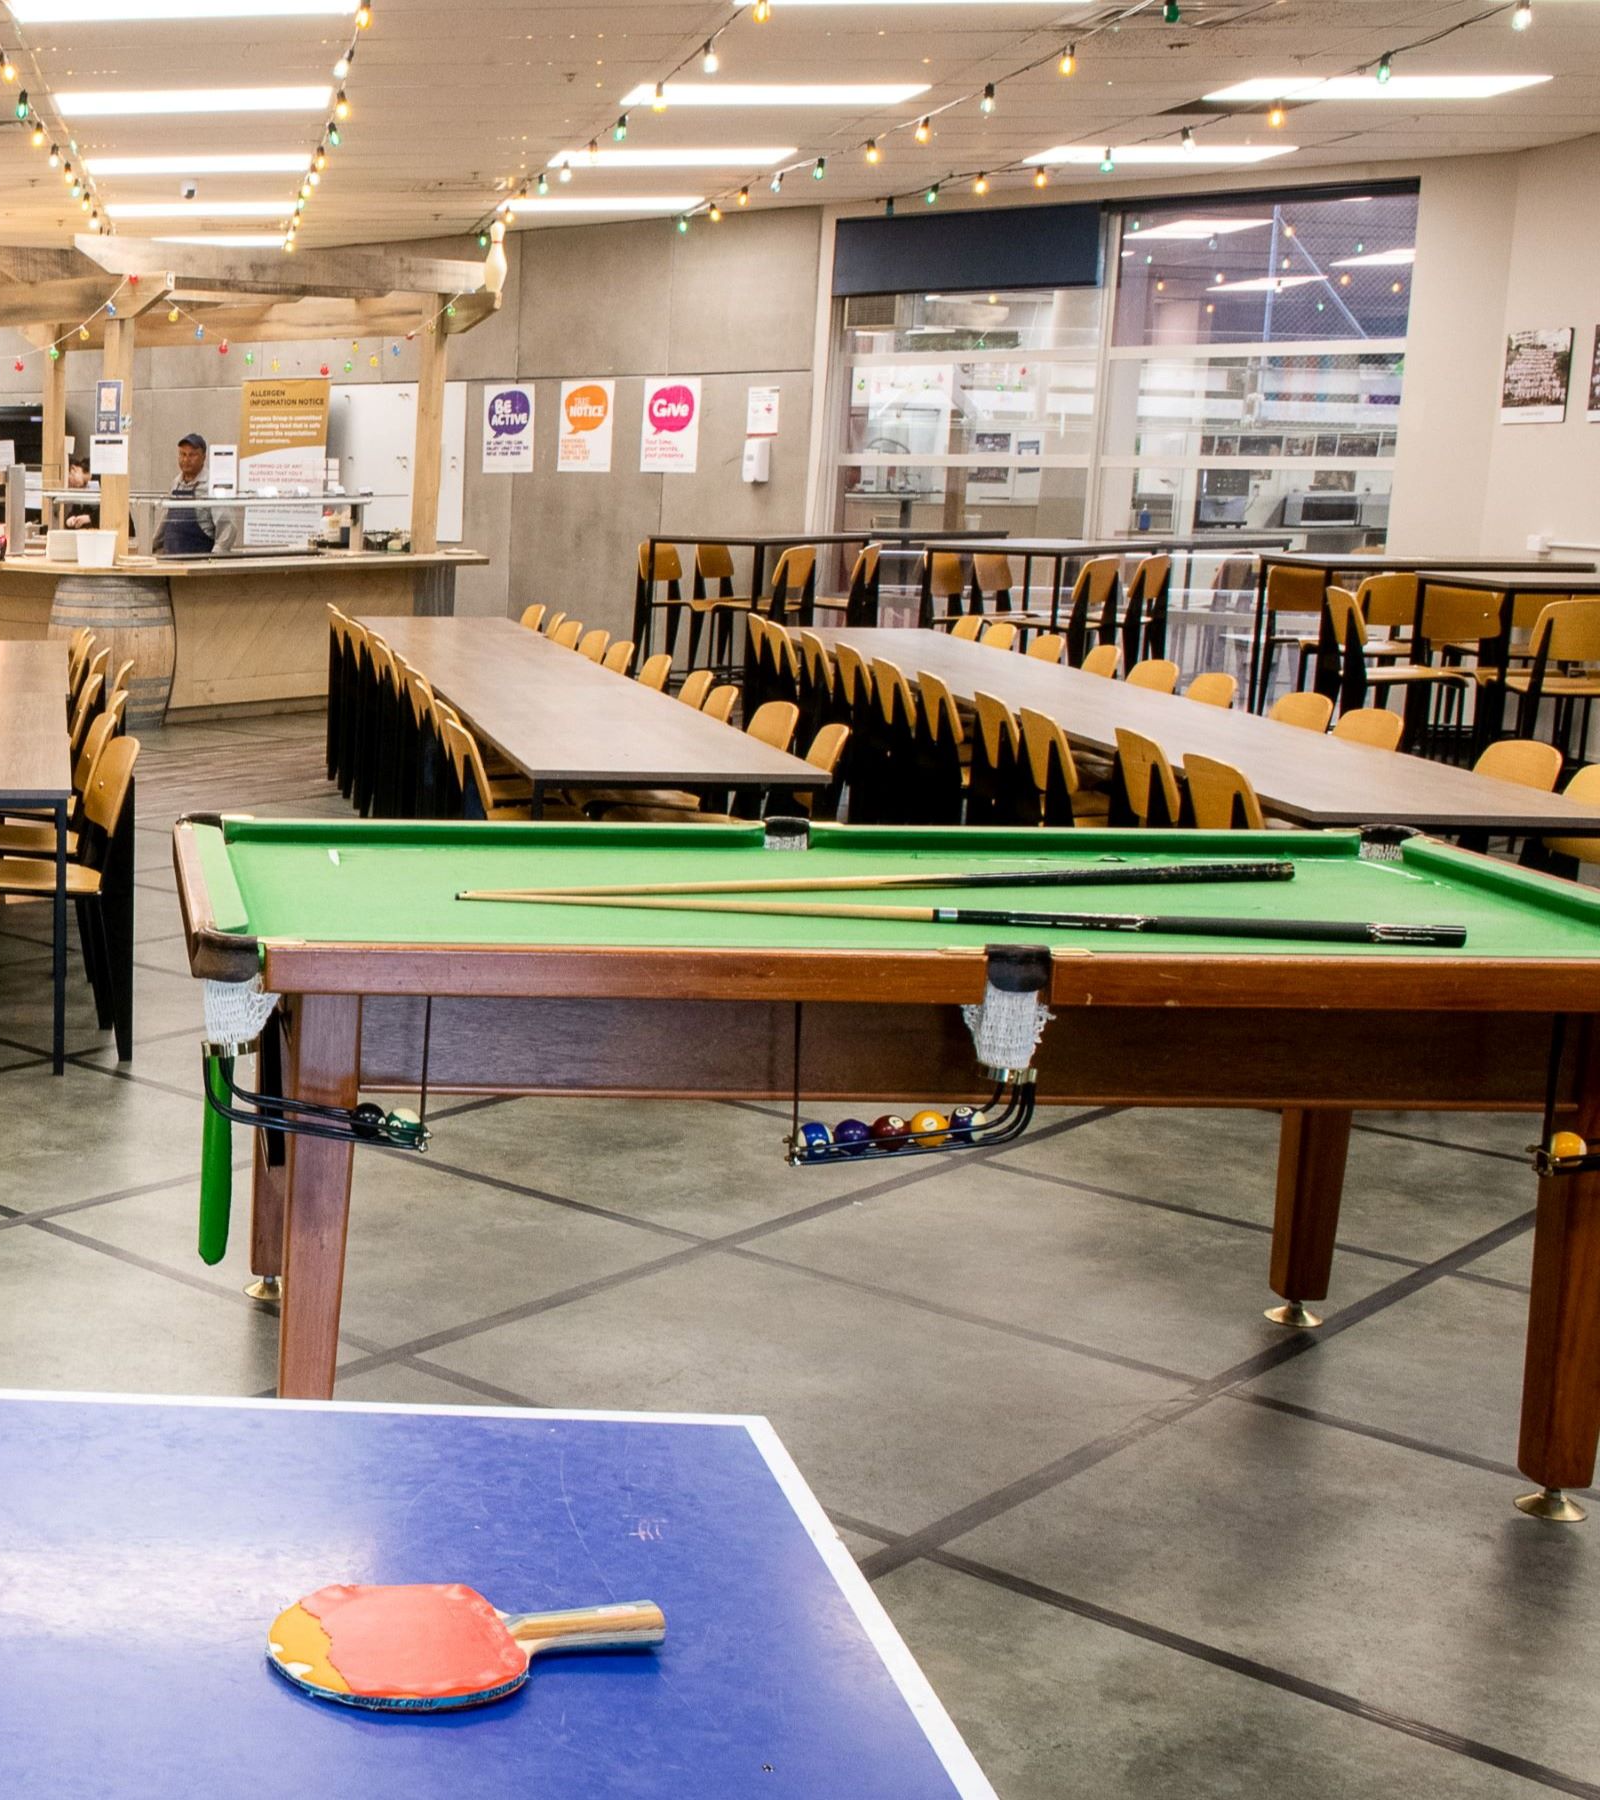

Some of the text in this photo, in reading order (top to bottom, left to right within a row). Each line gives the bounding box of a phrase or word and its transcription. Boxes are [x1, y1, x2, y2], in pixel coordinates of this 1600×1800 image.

[494, 399, 512, 414] BE
[569, 406, 605, 417] NOTICE
[652, 398, 690, 418] Give
[491, 413, 528, 426] ACTIVE
[353, 1693, 403, 1709] DOUBLE
[404, 1698, 434, 1709] FISH
